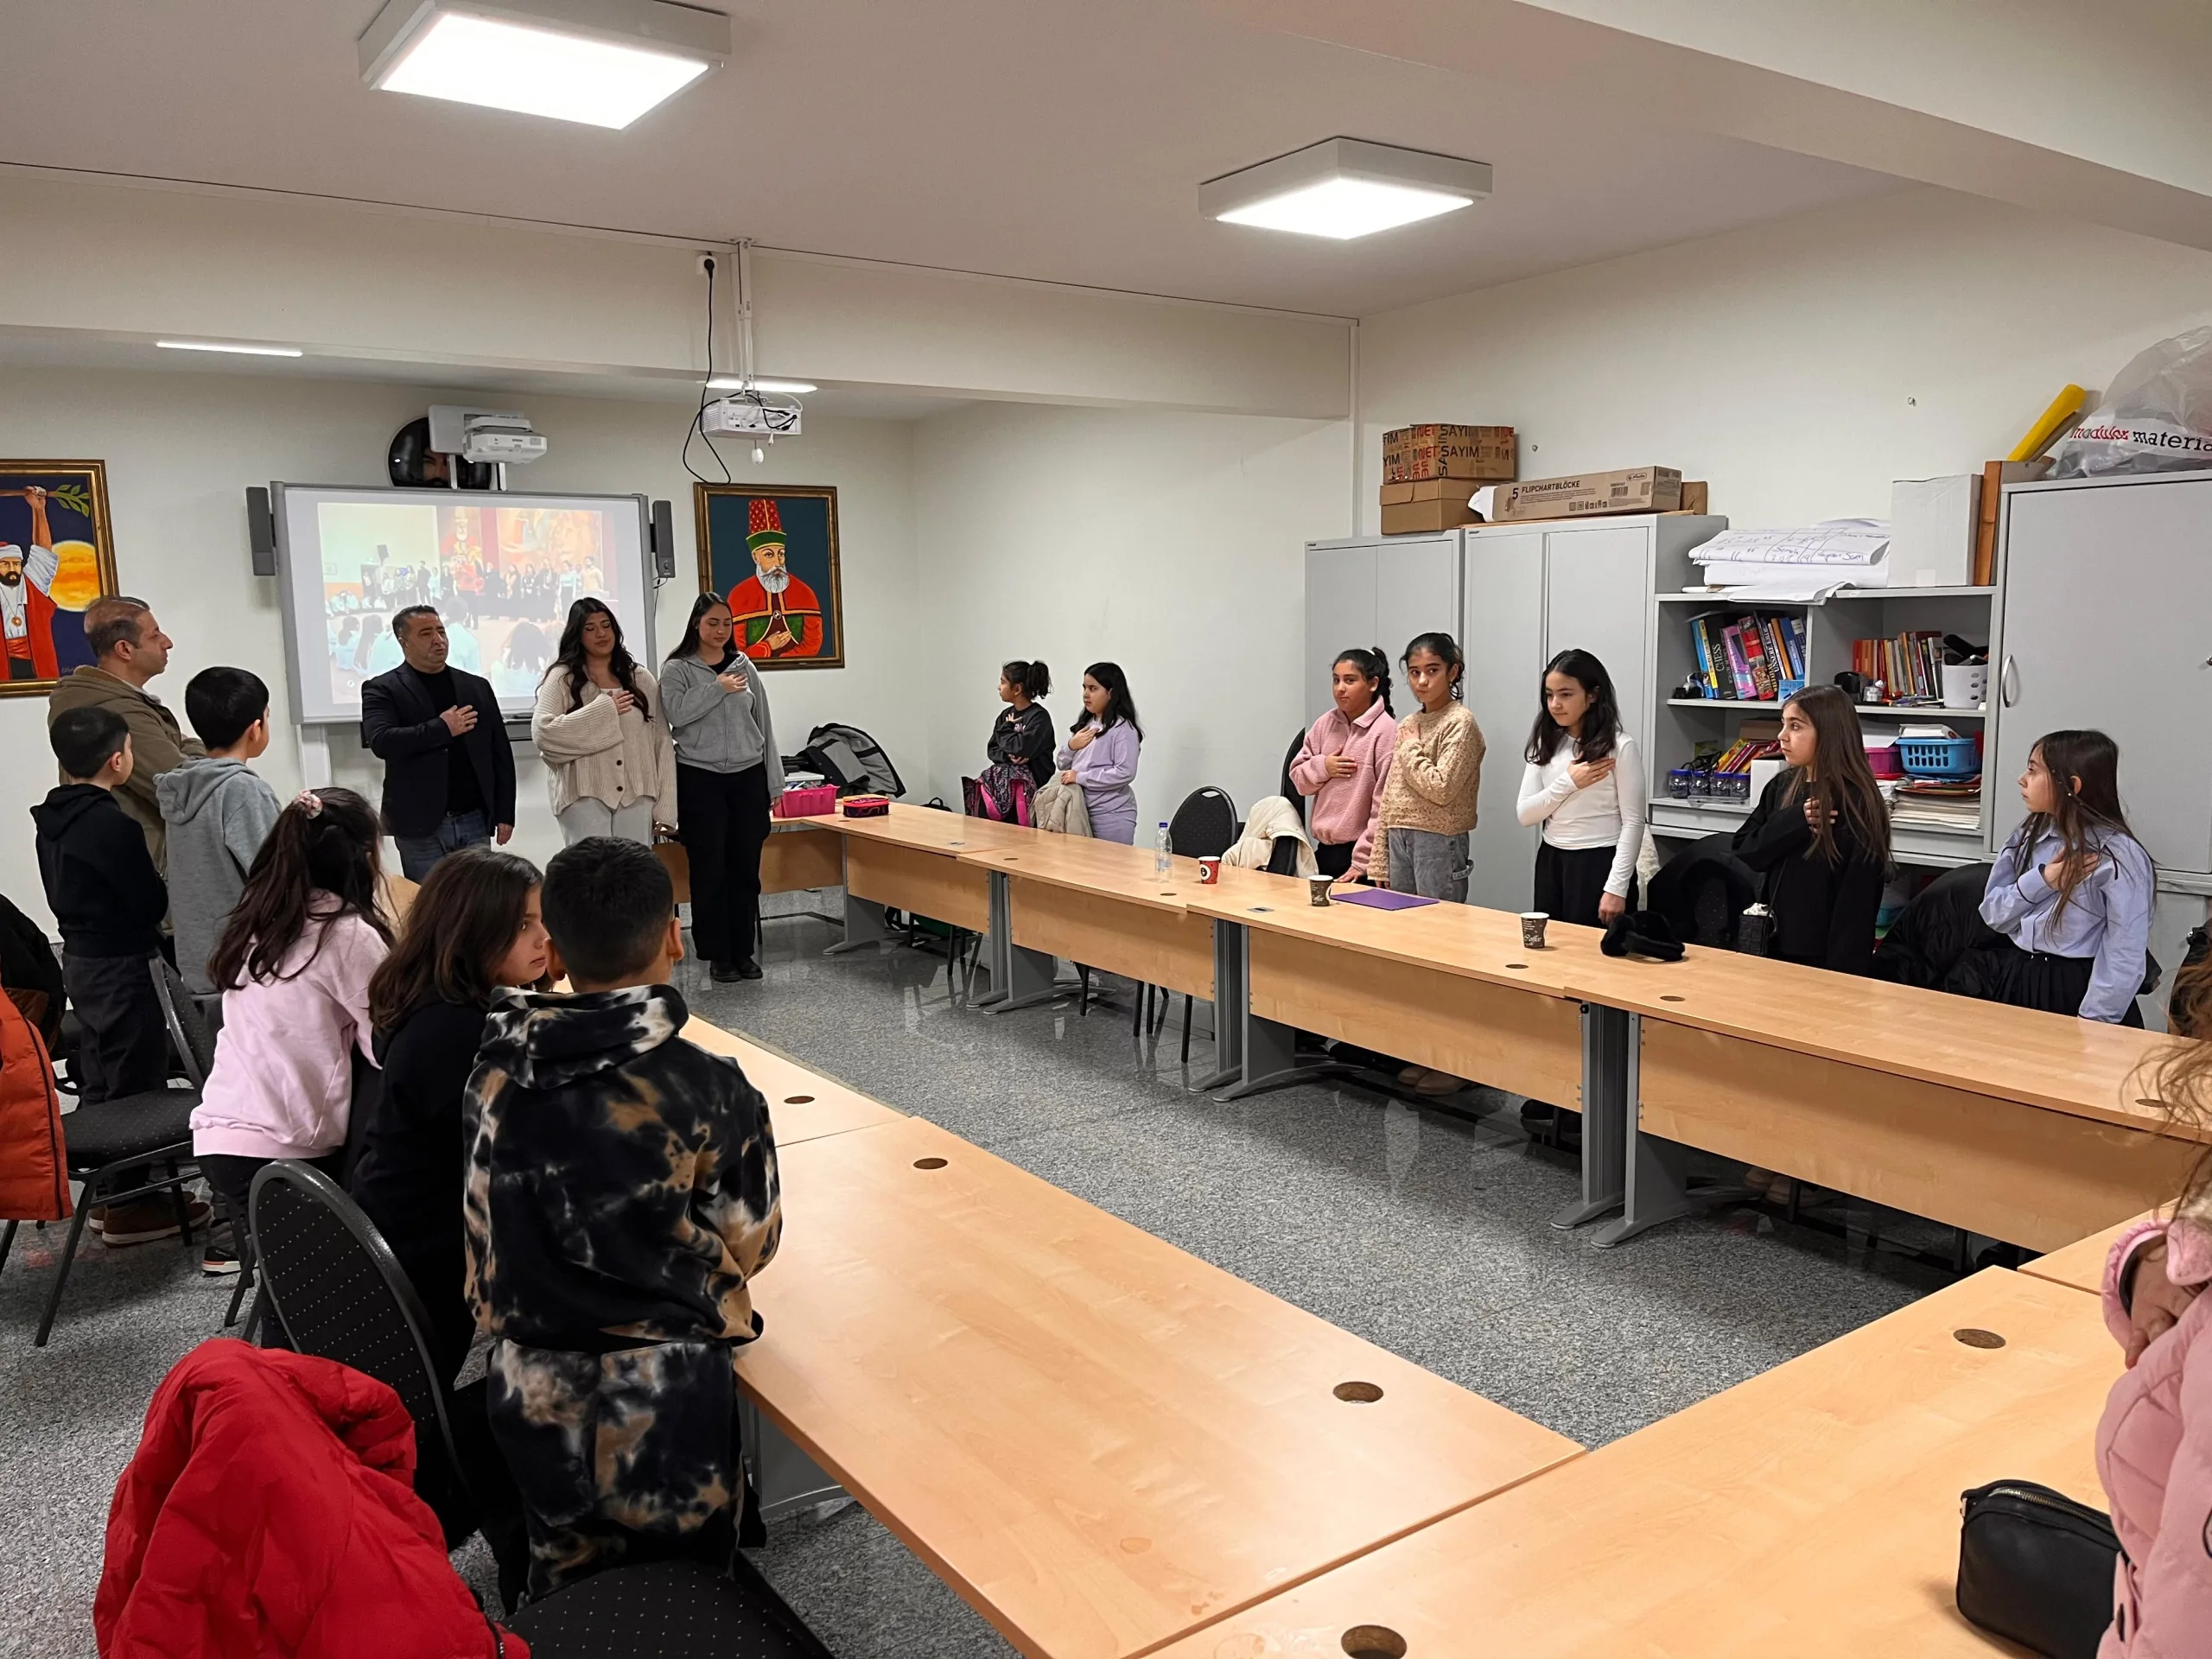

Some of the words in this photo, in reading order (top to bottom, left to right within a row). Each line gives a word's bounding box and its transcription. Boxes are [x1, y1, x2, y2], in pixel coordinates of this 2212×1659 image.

[1418, 446, 1438, 461] NET
[1441, 445, 1479, 458] SAYIM
[1512, 487, 1519, 499] 5
[1521, 480, 1581, 493] FLIPCHARTBLÖCKE
[1713, 644, 1725, 671] CHESS
